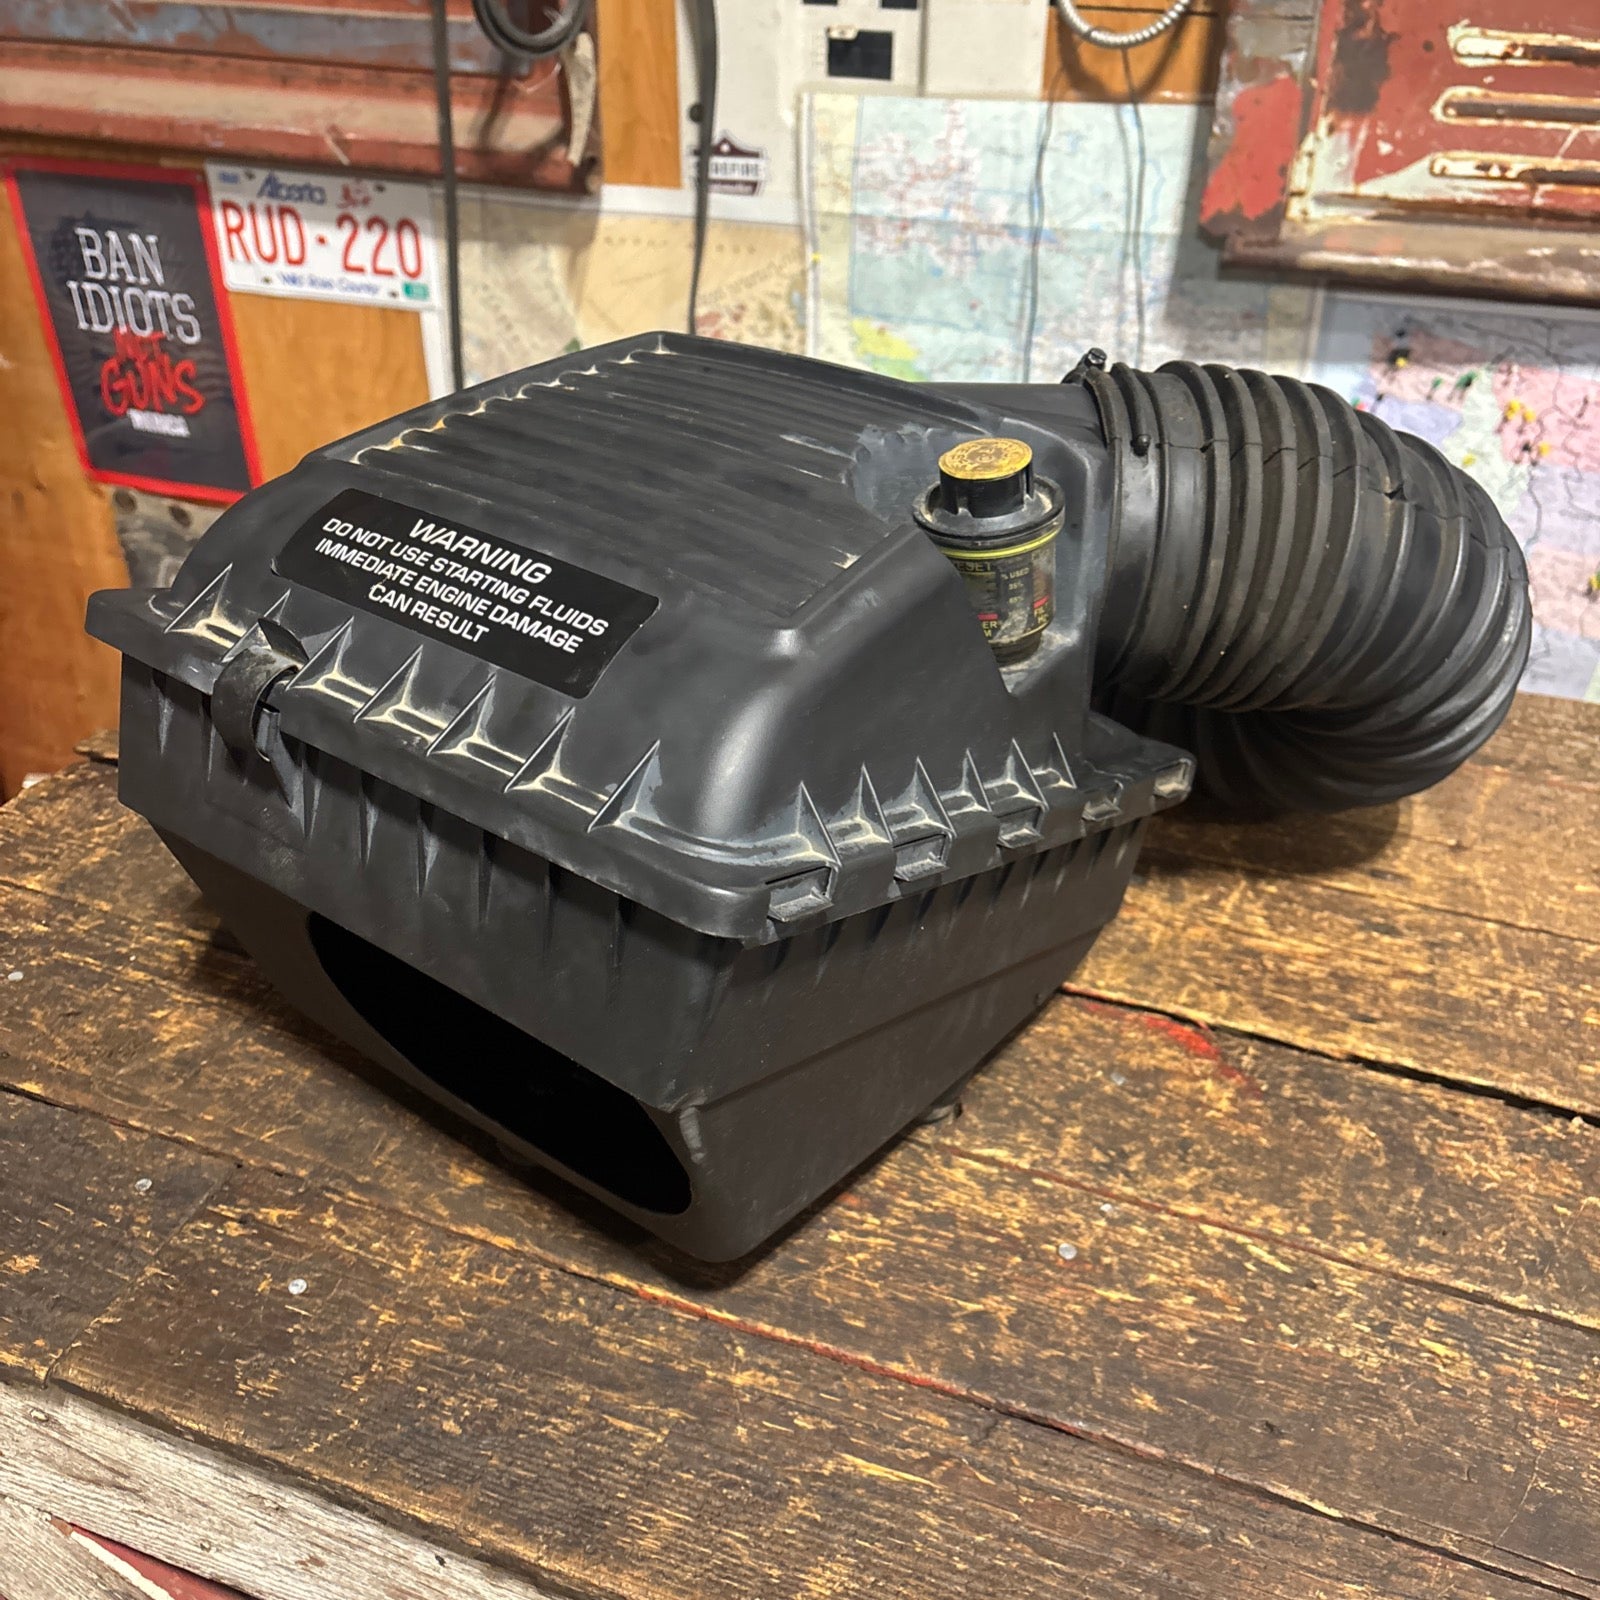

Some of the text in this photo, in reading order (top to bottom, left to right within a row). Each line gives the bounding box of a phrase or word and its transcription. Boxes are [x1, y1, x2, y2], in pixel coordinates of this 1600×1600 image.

[75, 227, 165, 287] BAN
[67, 281, 202, 345] IDIOTS
[101, 355, 206, 417] GUNS
[322, 517, 609, 636] DO NOT USE STARTING FLUIDS
[409, 518, 553, 584] WARNING
[314, 537, 584, 654] IMMEDIATE ENGINE DAMAGE
[368, 583, 490, 643] CAN RESULT
